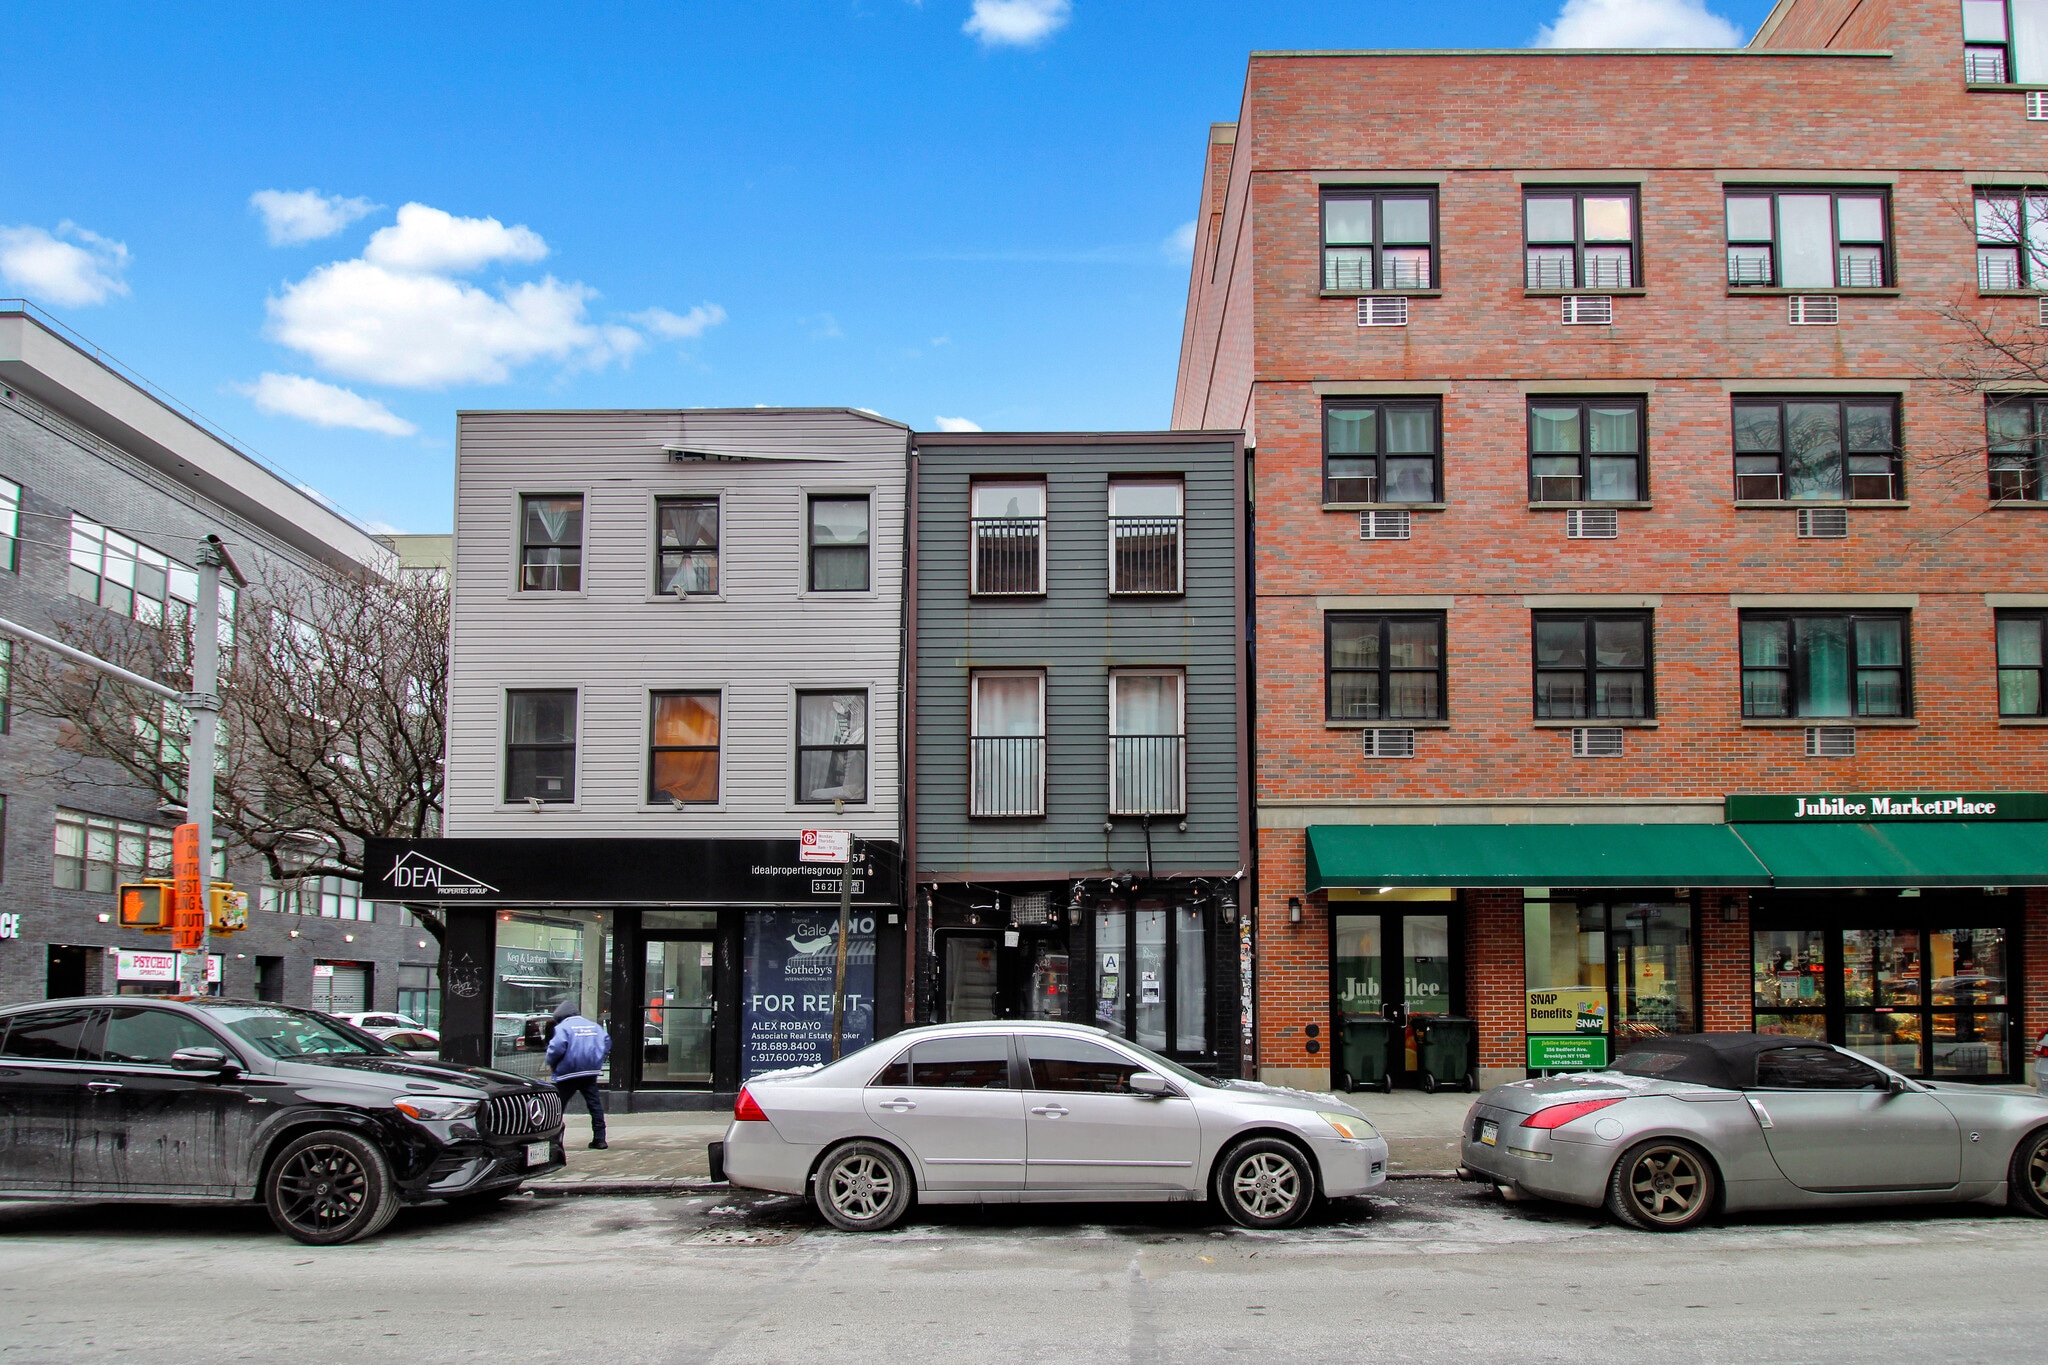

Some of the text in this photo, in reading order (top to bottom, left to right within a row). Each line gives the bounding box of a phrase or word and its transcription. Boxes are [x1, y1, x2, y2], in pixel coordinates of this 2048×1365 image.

[1795, 797, 1996, 818] Jubilee MarketPlace
[394, 854, 450, 888] IDEAL
[751, 865, 864, 876] idealpropertiesgroupom
[814, 883, 833, 891] 362
[797, 923, 827, 937] Gale
[133, 955, 173, 969] PSYCHIC
[1105, 956, 1116, 968] A
[784, 965, 832, 976] Sotheby's
[752, 994, 795, 1012] FOR
[1530, 994, 1558, 1005] SNAP
[1530, 1008, 1572, 1019] Benefits
[751, 1022, 822, 1031] ALEX ROBAYO
[1576, 1019, 1604, 1028] SNAP
[751, 1032, 788, 1040] Associate
[790, 1032, 806, 1040] Real
[808, 1032, 833, 1040] Estate
[751, 1042, 816, 1051] 718.689.8400
[751, 1053, 822, 1062] c.917.600.7928
